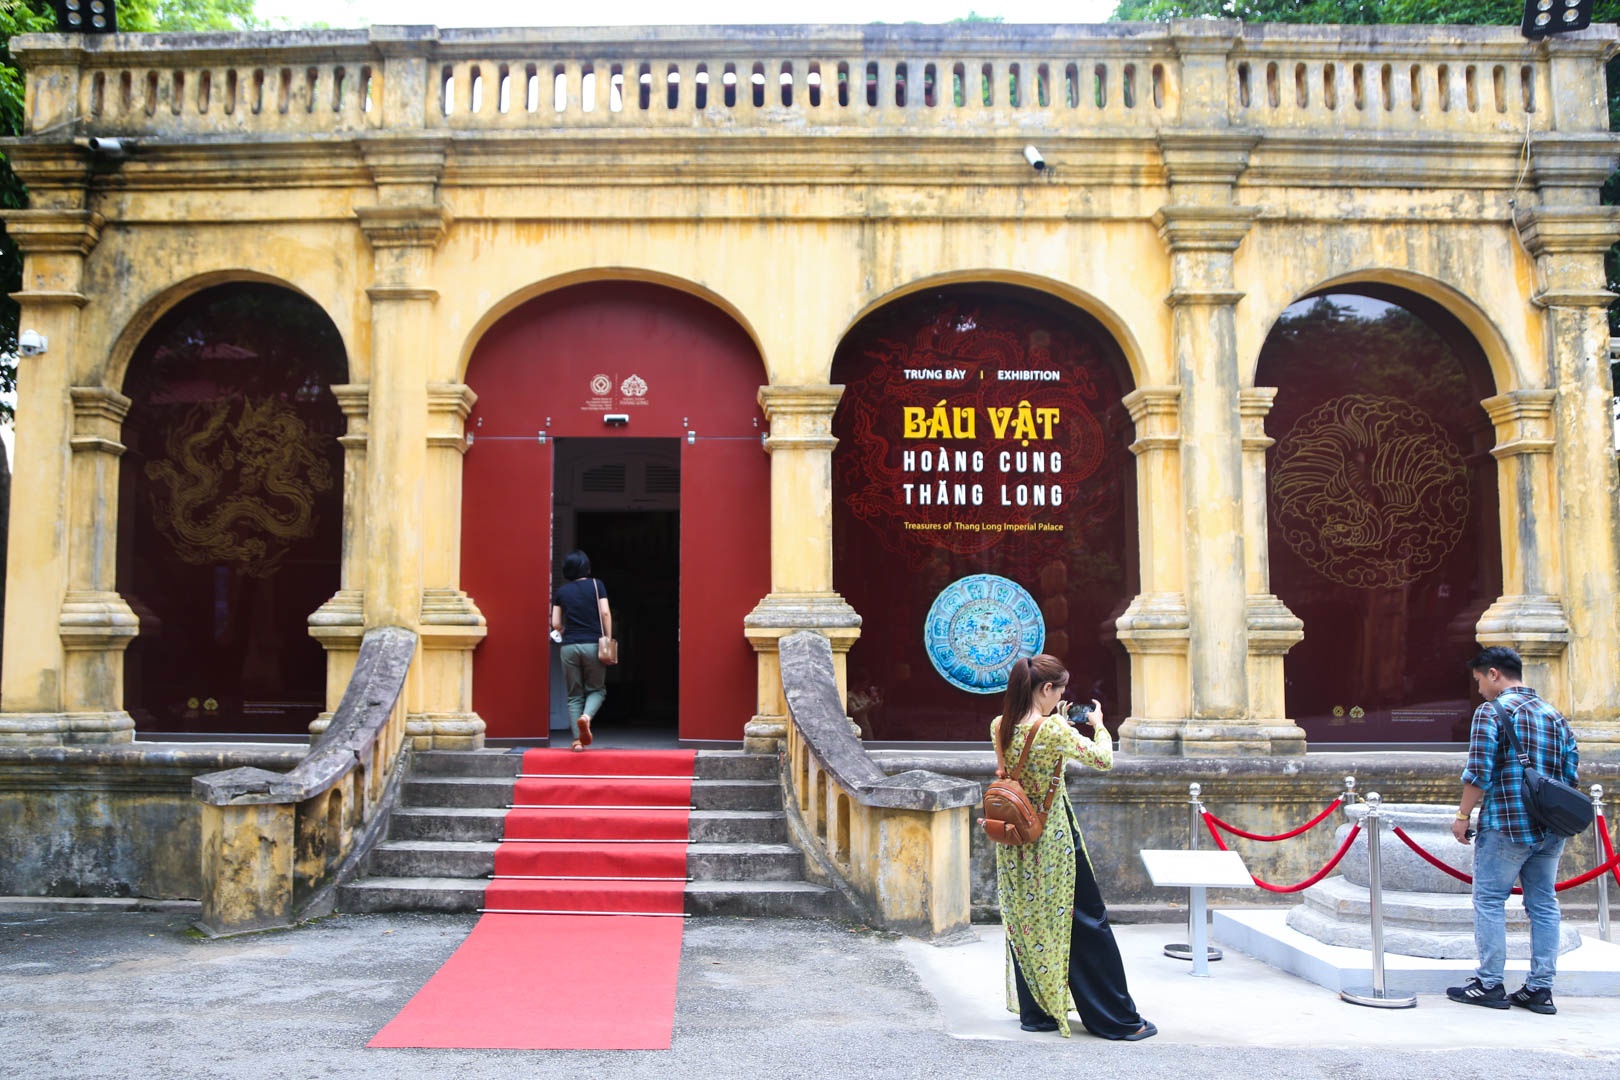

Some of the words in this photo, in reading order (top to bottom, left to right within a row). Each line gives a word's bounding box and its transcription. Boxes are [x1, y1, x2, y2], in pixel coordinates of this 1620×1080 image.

[904, 369, 942, 380] TRƯNG
[946, 368, 966, 380] BÀY
[998, 370, 1060, 381] EXHIBITION
[903, 399, 976, 439] BÁU
[987, 400, 1059, 447] VẬT
[903, 447, 984, 472] HOÀNG
[999, 452, 1062, 472] CUNG
[903, 481, 983, 505] THĂNG
[1001, 485, 1062, 506] LONG
[905, 522, 941, 530] Treasures
[943, 522, 952, 530] of
[955, 522, 980, 532] Thang
[982, 523, 1001, 532] Long
[1004, 523, 1036, 532] Imperial
[1039, 523, 1063, 531] Palace
